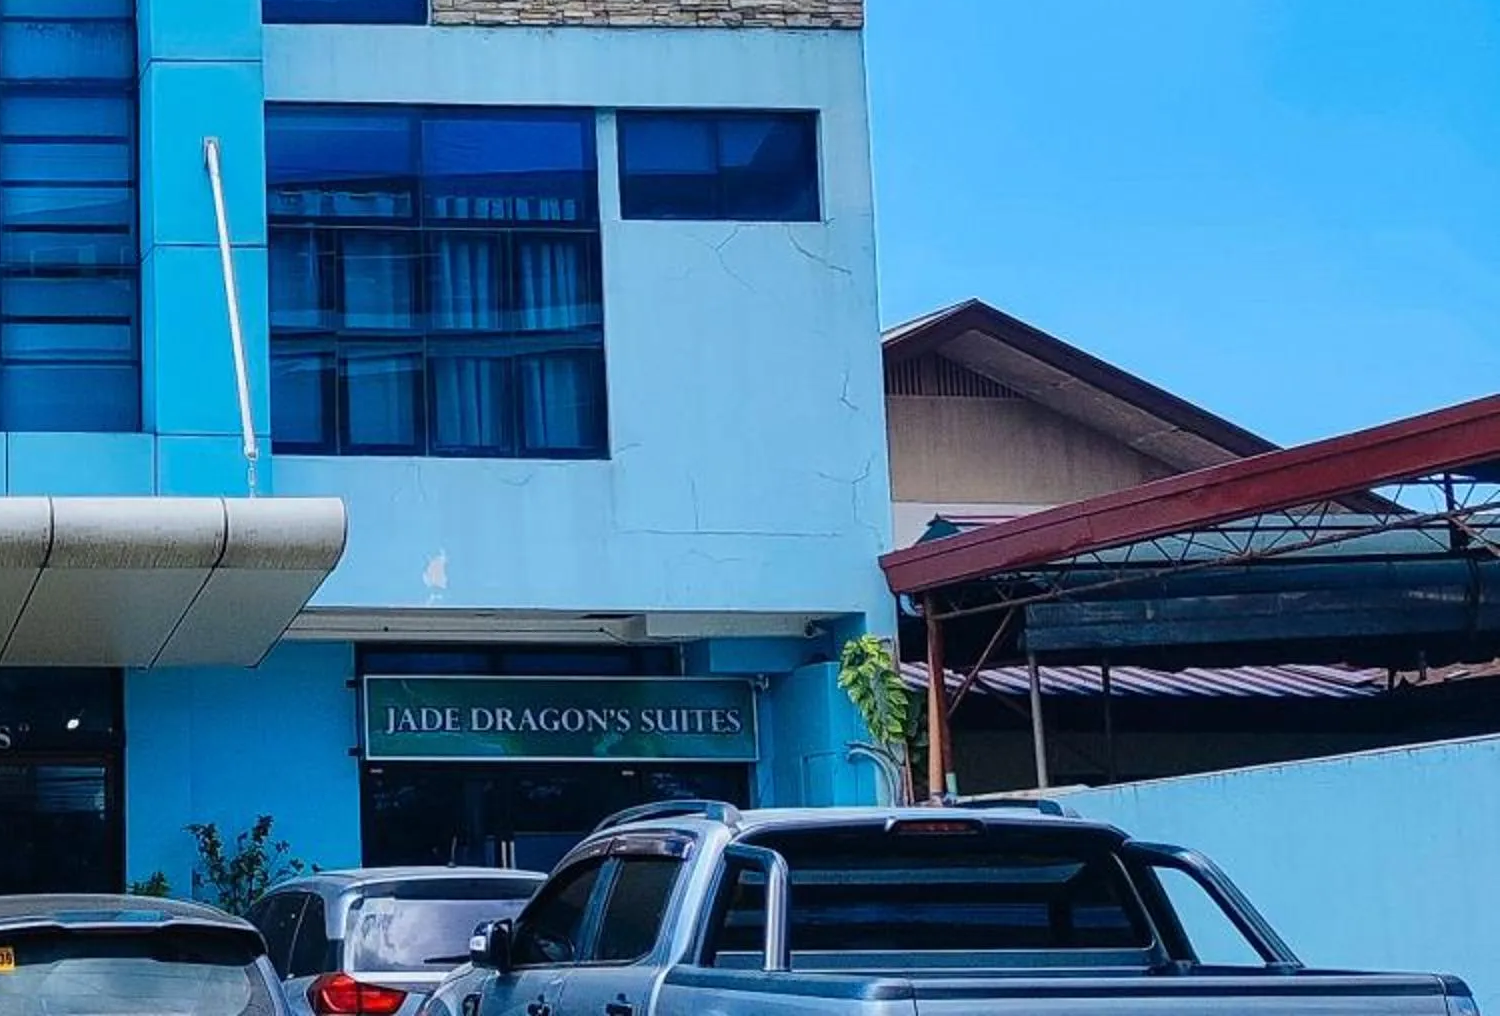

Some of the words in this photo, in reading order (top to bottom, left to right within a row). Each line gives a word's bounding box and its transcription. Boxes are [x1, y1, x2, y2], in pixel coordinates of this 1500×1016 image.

[386, 706, 461, 735] JADE
[471, 706, 631, 733] DRAGON'S
[640, 708, 741, 734] SUITES
